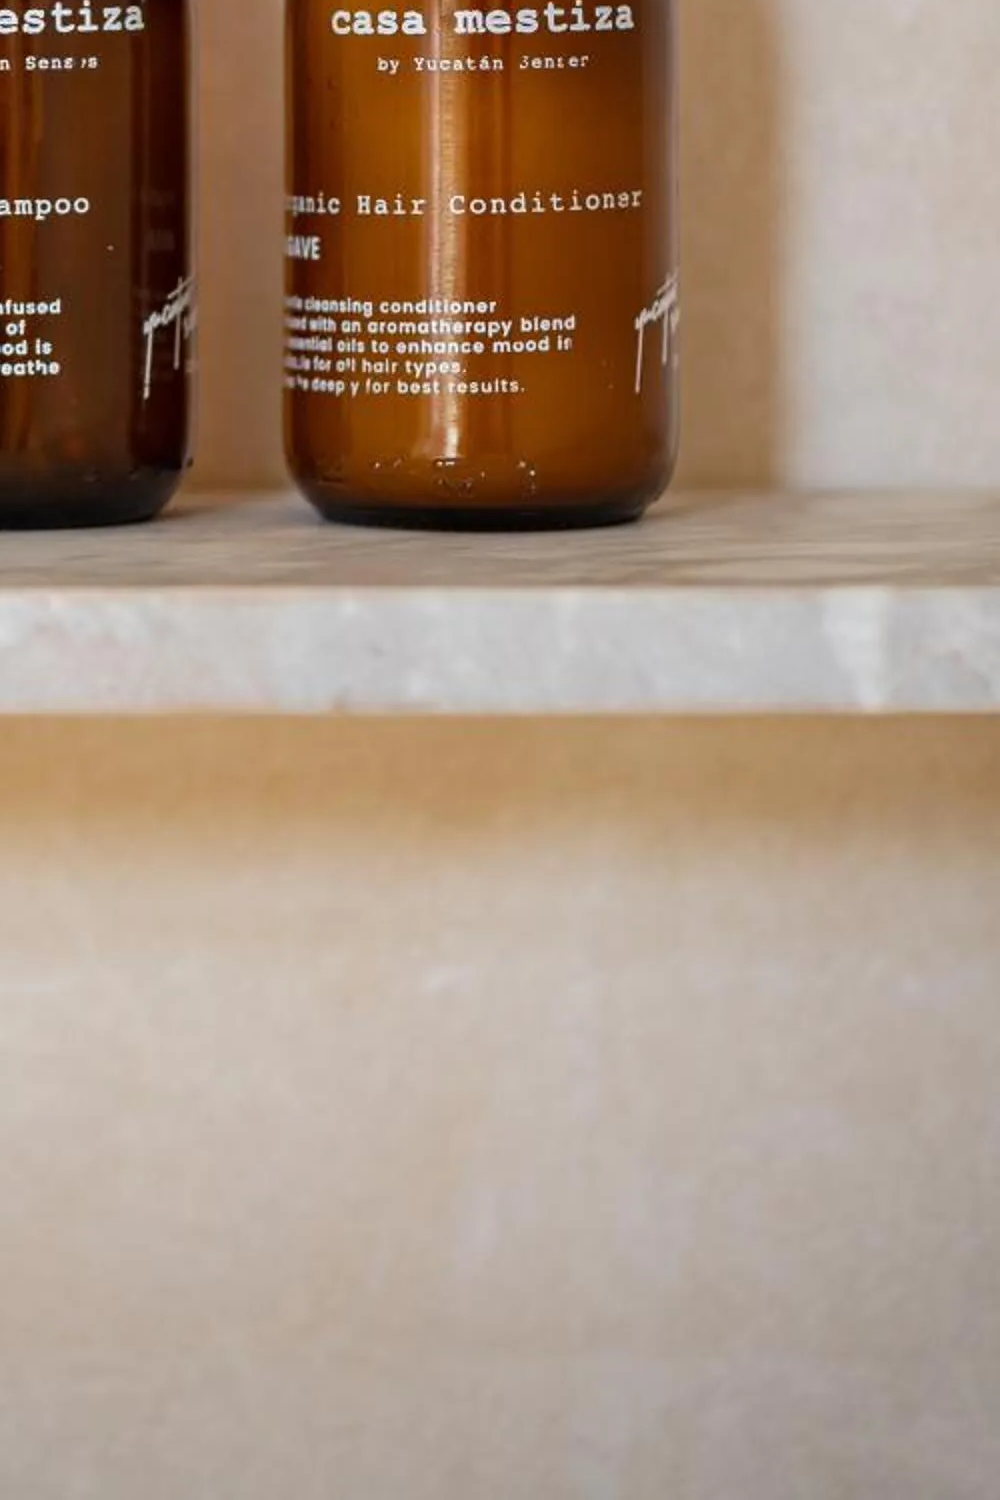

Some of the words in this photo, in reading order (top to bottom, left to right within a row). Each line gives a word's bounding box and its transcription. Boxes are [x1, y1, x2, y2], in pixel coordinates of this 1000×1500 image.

[331, 9, 426, 35] casa
[453, 0, 635, 34] mestiza
[377, 57, 400, 73] by
[414, 56, 504, 71] Yucatán
[357, 193, 427, 216] Hair
[450, 190, 643, 215] Conditioner
[379, 299, 497, 315] conditioner
[6, 320, 26, 336] of
[341, 319, 361, 334] an
[367, 318, 513, 338] aromatherapy
[520, 315, 577, 333] blend
[336, 337, 366, 353] oils
[371, 338, 390, 354] to
[395, 339, 485, 355] enhance
[492, 335, 551, 353] mood
[313, 355, 332, 373] for
[361, 357, 399, 374] hair
[405, 358, 468, 378] types.
[365, 377, 391, 394] for
[397, 377, 440, 395] best
[446, 378, 526, 395] results.
